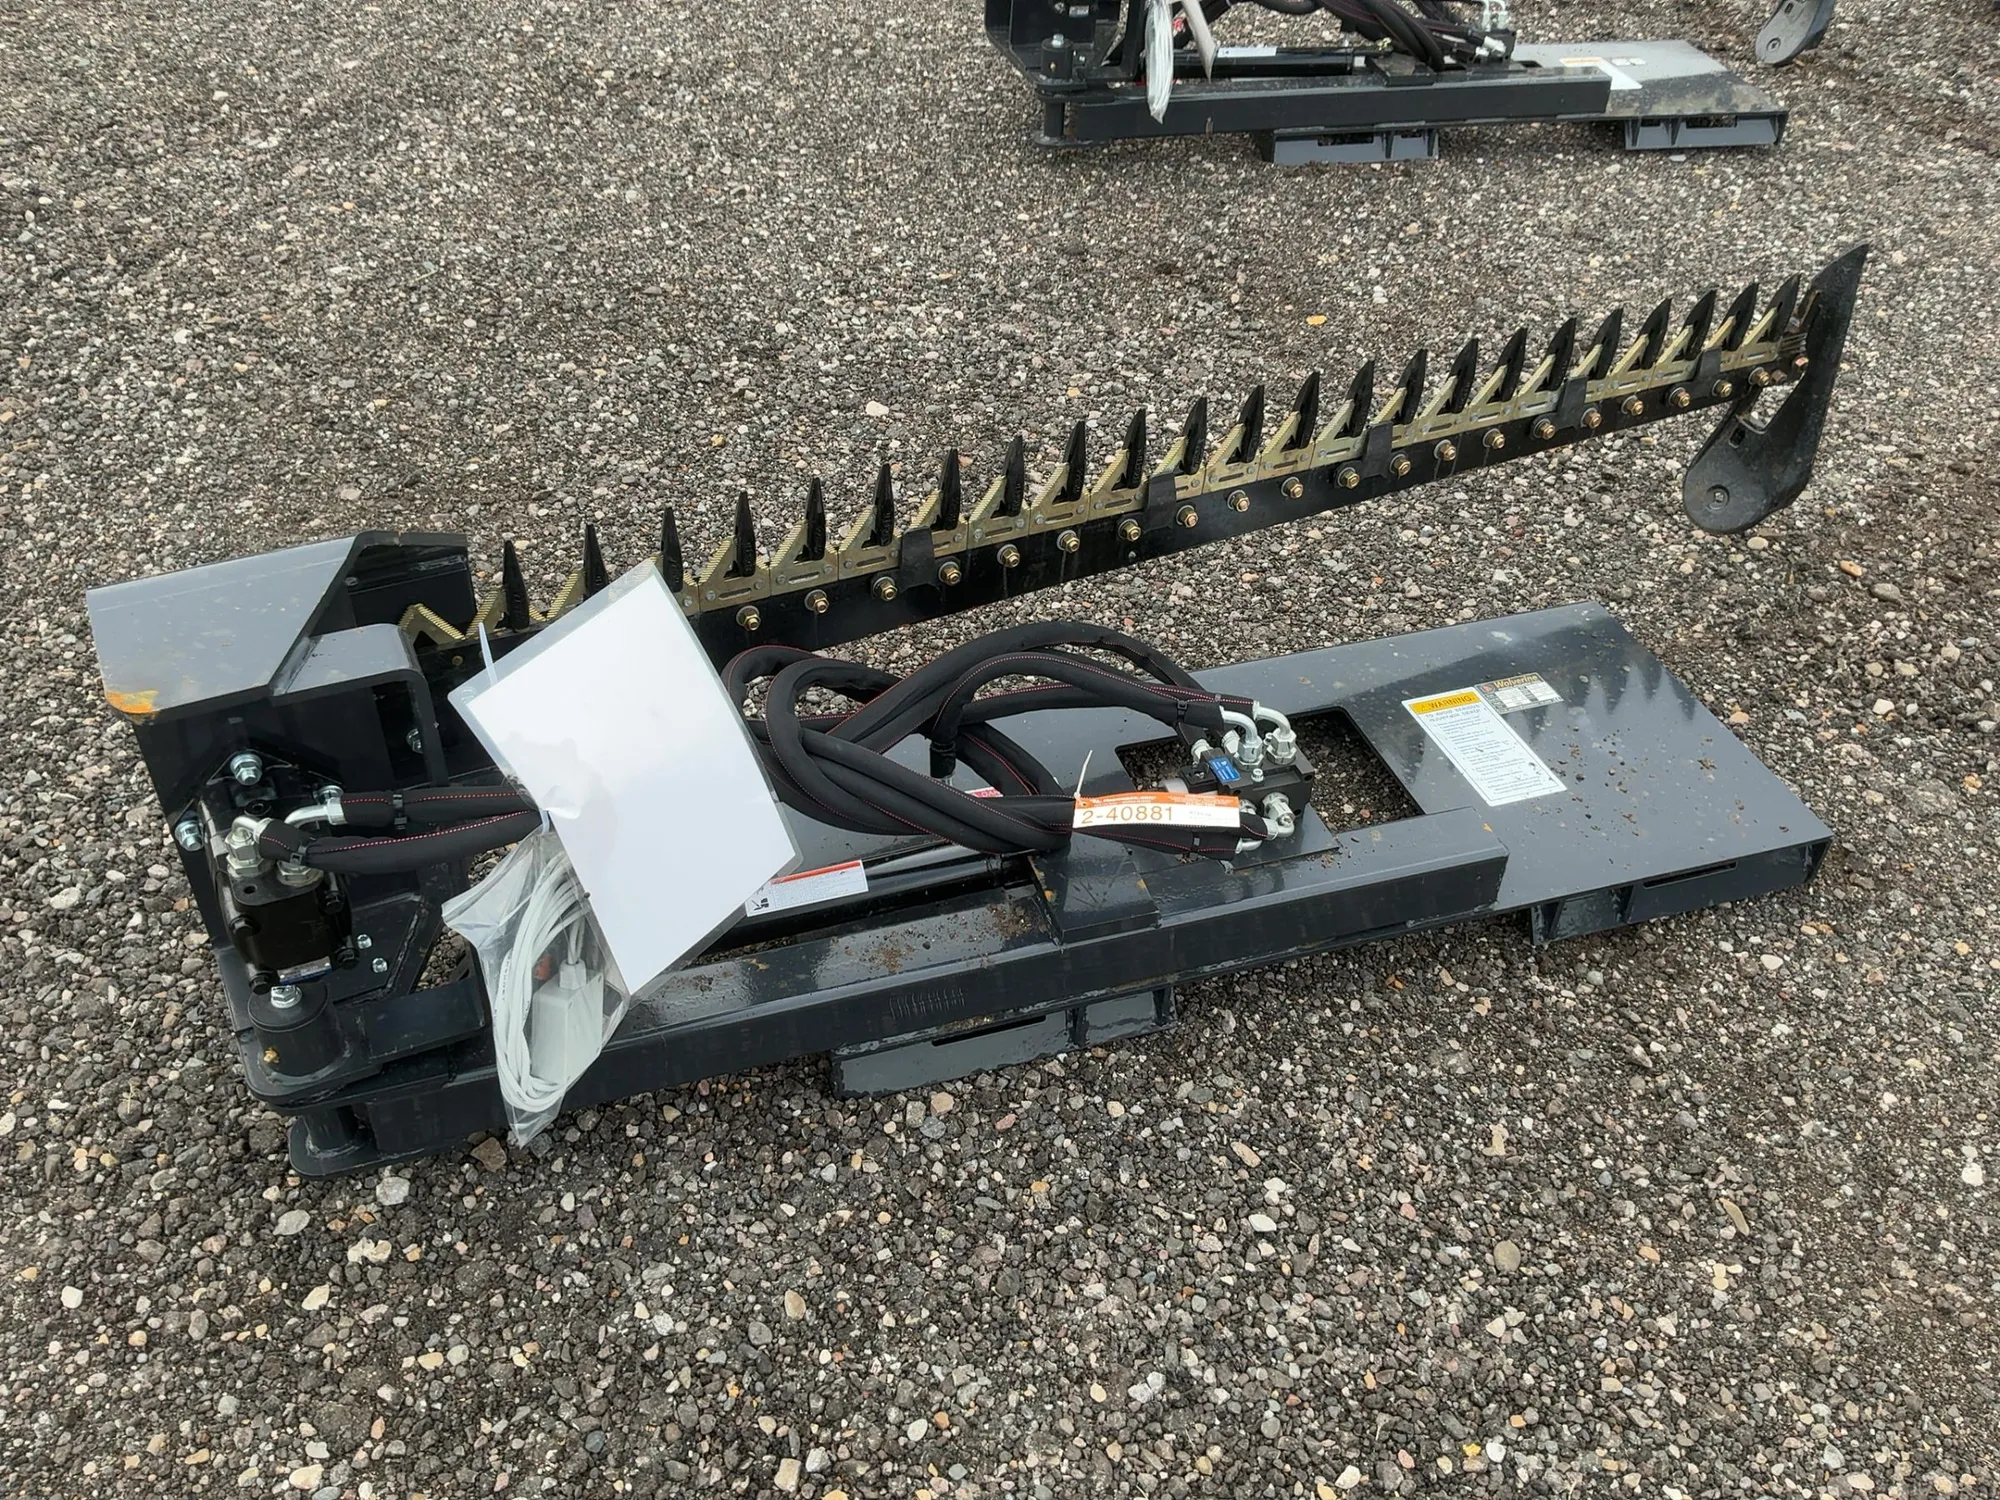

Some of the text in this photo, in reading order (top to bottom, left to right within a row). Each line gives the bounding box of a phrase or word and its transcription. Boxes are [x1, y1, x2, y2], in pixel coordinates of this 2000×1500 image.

[1493, 675, 1538, 688] Wolverine
[1428, 695, 1472, 709] WARNING
[1081, 805, 1172, 824] 2-40881
